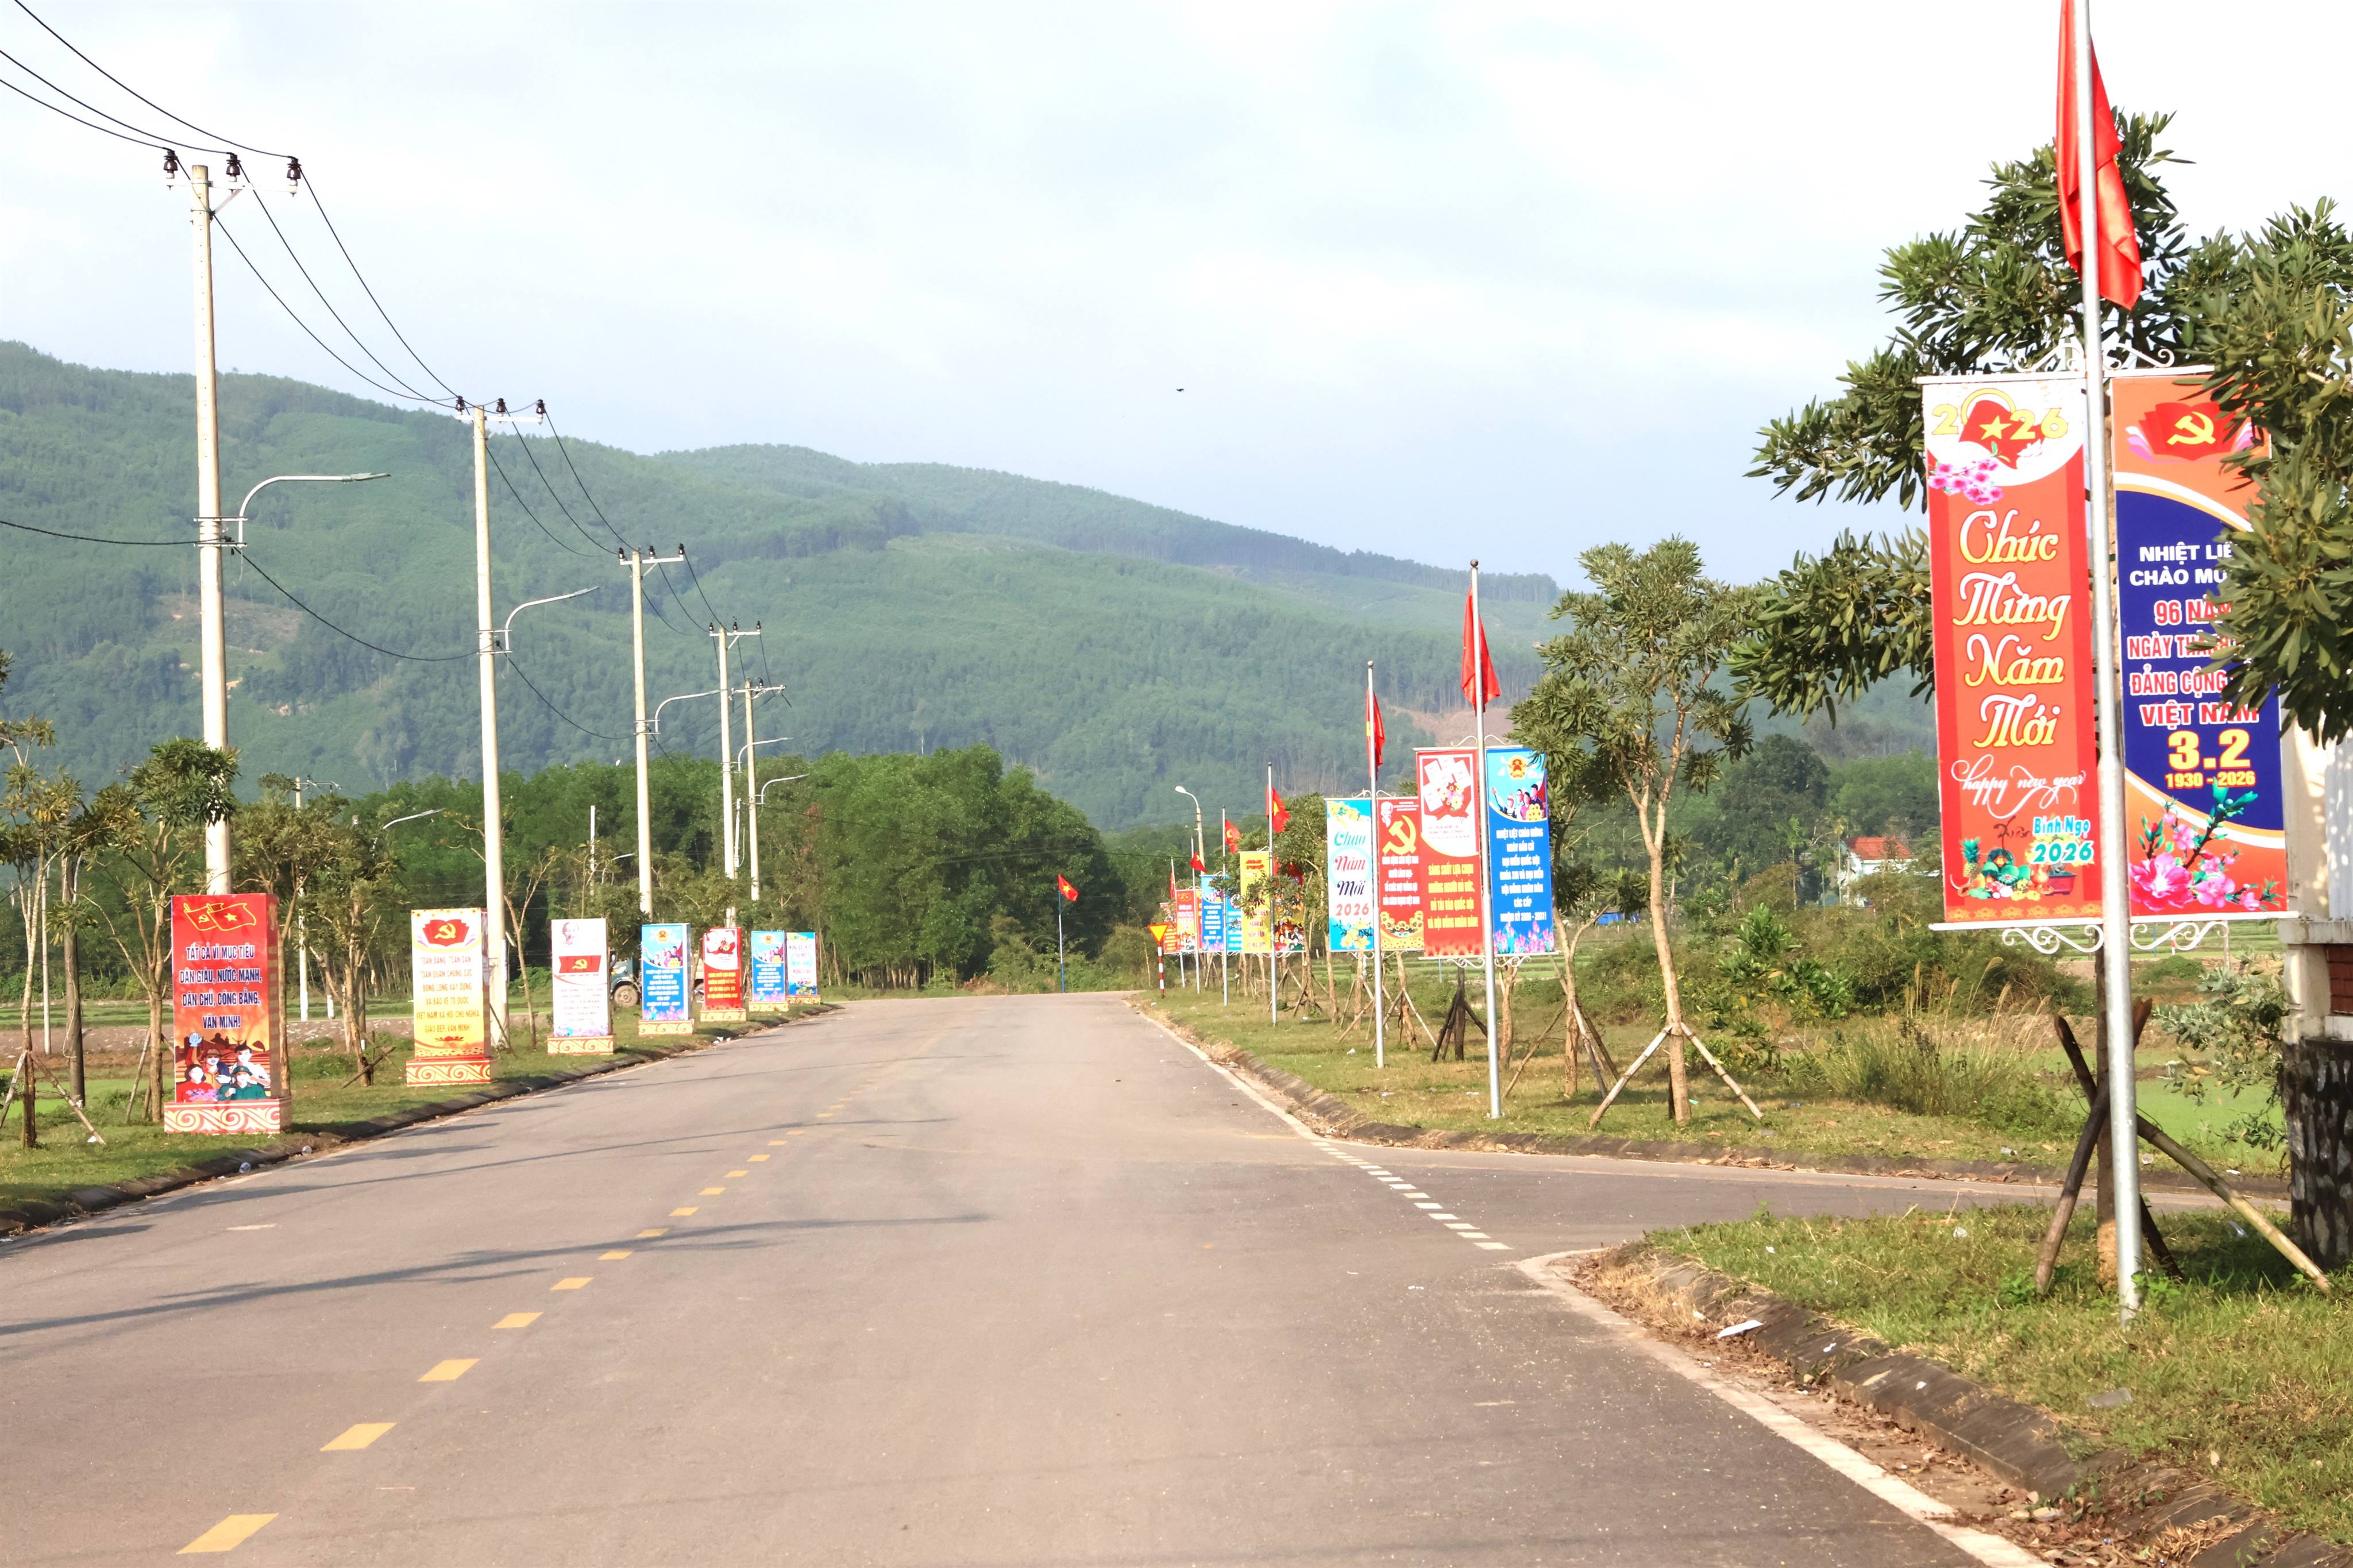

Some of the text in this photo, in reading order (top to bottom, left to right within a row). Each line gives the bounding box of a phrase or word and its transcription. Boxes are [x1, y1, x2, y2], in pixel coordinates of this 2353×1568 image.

[1959, 509, 2059, 563] Chúc
[2139, 541, 2200, 565] NHIỆT
[2130, 566, 2189, 586] CHÀO
[1953, 571, 2071, 641] Mừng
[2154, 600, 2182, 625] 96
[2127, 631, 2174, 659] NGÀY
[1965, 634, 2064, 686] Năm
[2130, 663, 2178, 696] ĐẢNG
[2181, 666, 2228, 698] CỘNG
[1973, 693, 2061, 748] Mới
[2139, 700, 2260, 730] VIỆT NAM
[2167, 728, 2251, 771] 3.2
[1951, 754, 2086, 818] happy new year
[2165, 773, 2204, 790] 1930
[2216, 770, 2256, 788] 2026
[2064, 814, 2090, 839] Ngọ
[2032, 841, 2094, 863] 2026
[1336, 903, 1370, 917] 2026
[221, 945, 237, 962] MỤC
[219, 1015, 241, 1029] MINH!
